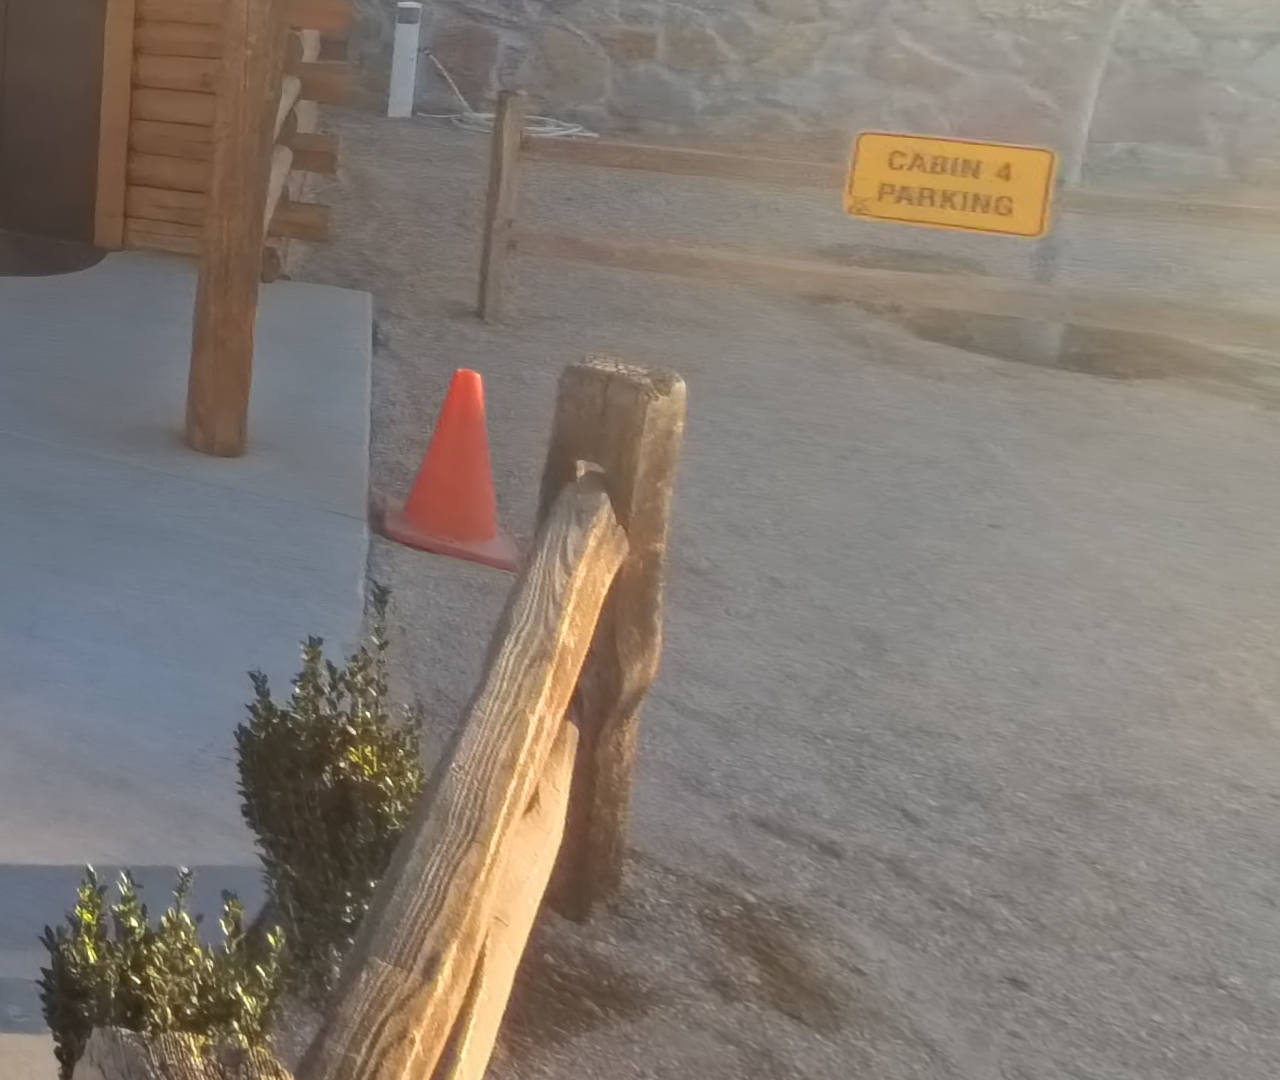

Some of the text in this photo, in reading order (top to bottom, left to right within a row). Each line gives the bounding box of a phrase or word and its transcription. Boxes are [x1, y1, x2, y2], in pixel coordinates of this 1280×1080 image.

[887, 150, 1013, 182] CABIN 4
[878, 183, 1013, 216] PARKING
